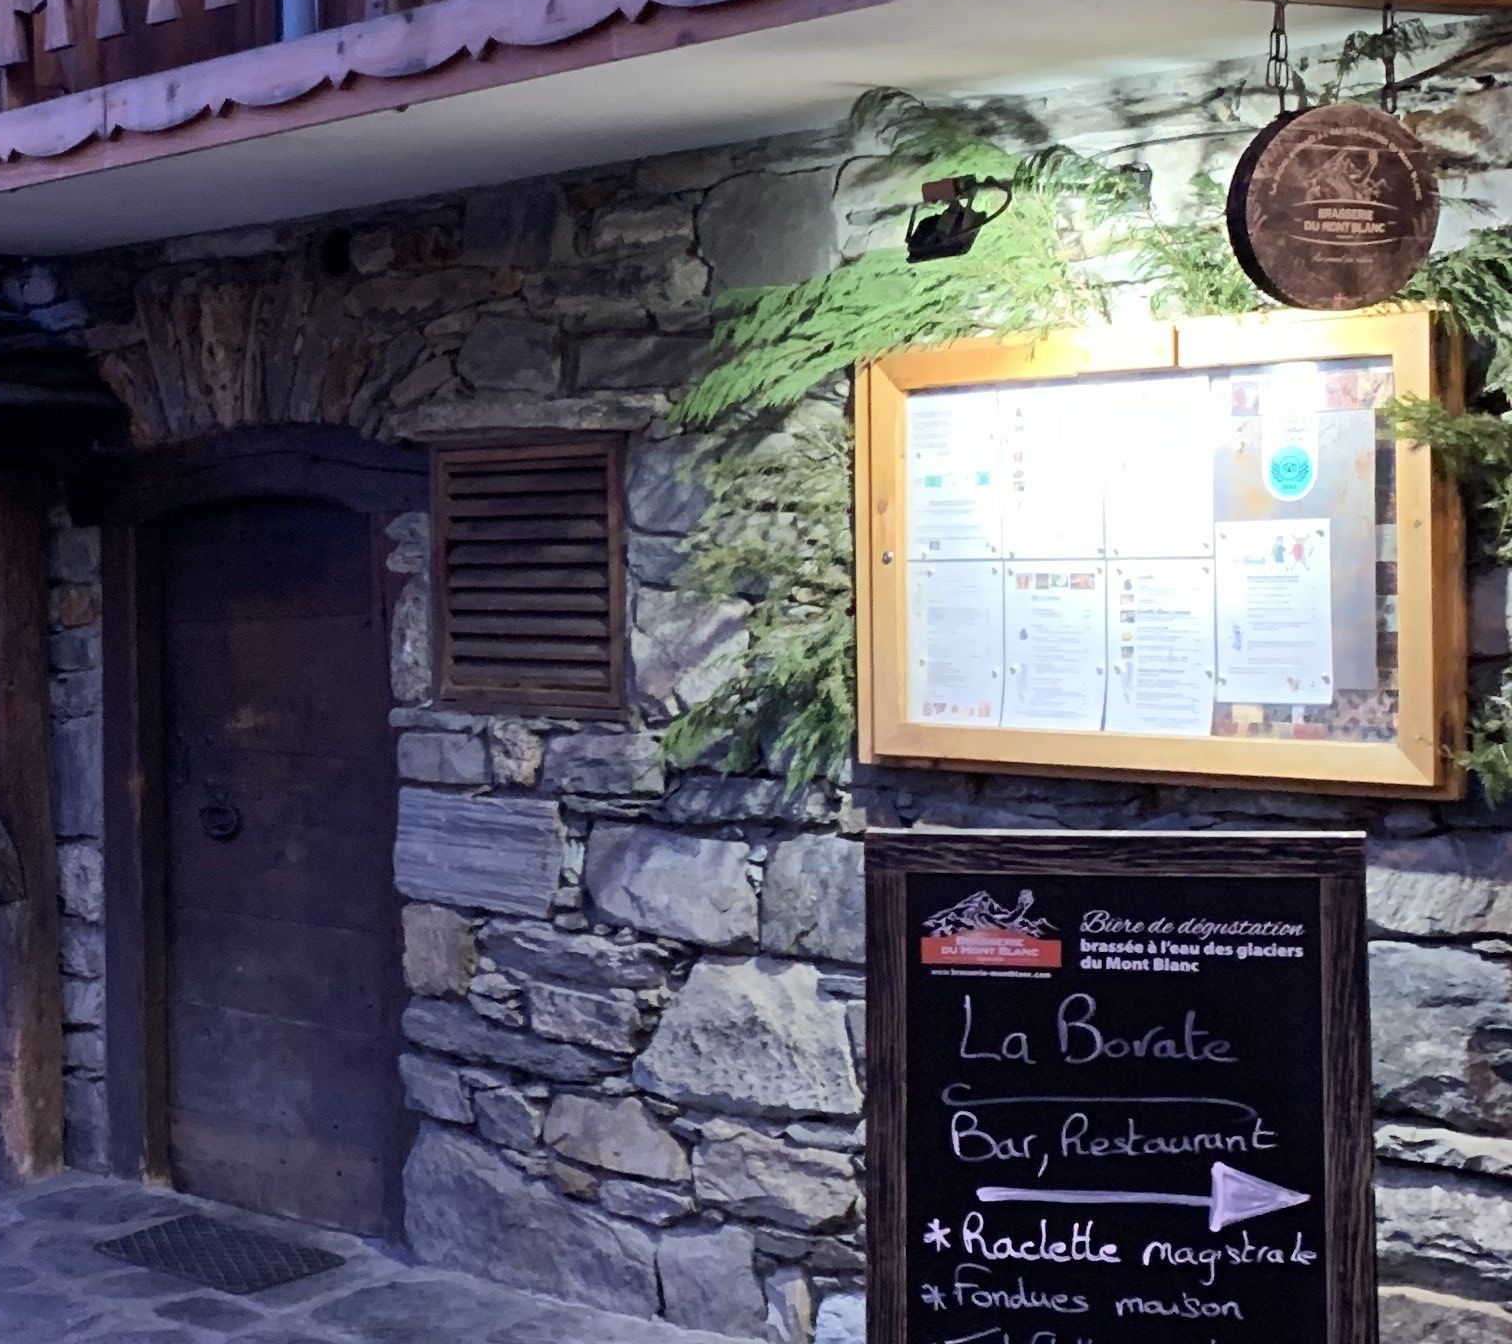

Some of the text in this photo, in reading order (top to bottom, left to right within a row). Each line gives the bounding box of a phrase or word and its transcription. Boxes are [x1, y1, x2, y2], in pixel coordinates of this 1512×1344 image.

[1303, 220, 1386, 234] DU MONT BLANC
[1080, 909, 1306, 941] Bière de dégustation
[941, 946, 958, 955] DU
[999, 947, 1041, 957] BLANC
[1080, 938, 1305, 960] brassée à l'eau des glaciers
[1080, 955, 1201, 973] du Mont Blanc
[958, 994, 1037, 1065] La
[1060, 1112, 1279, 1158] Restaurant
[961, 1211, 1123, 1264] Raclette
[953, 1263, 1245, 1321] Fondues maison
